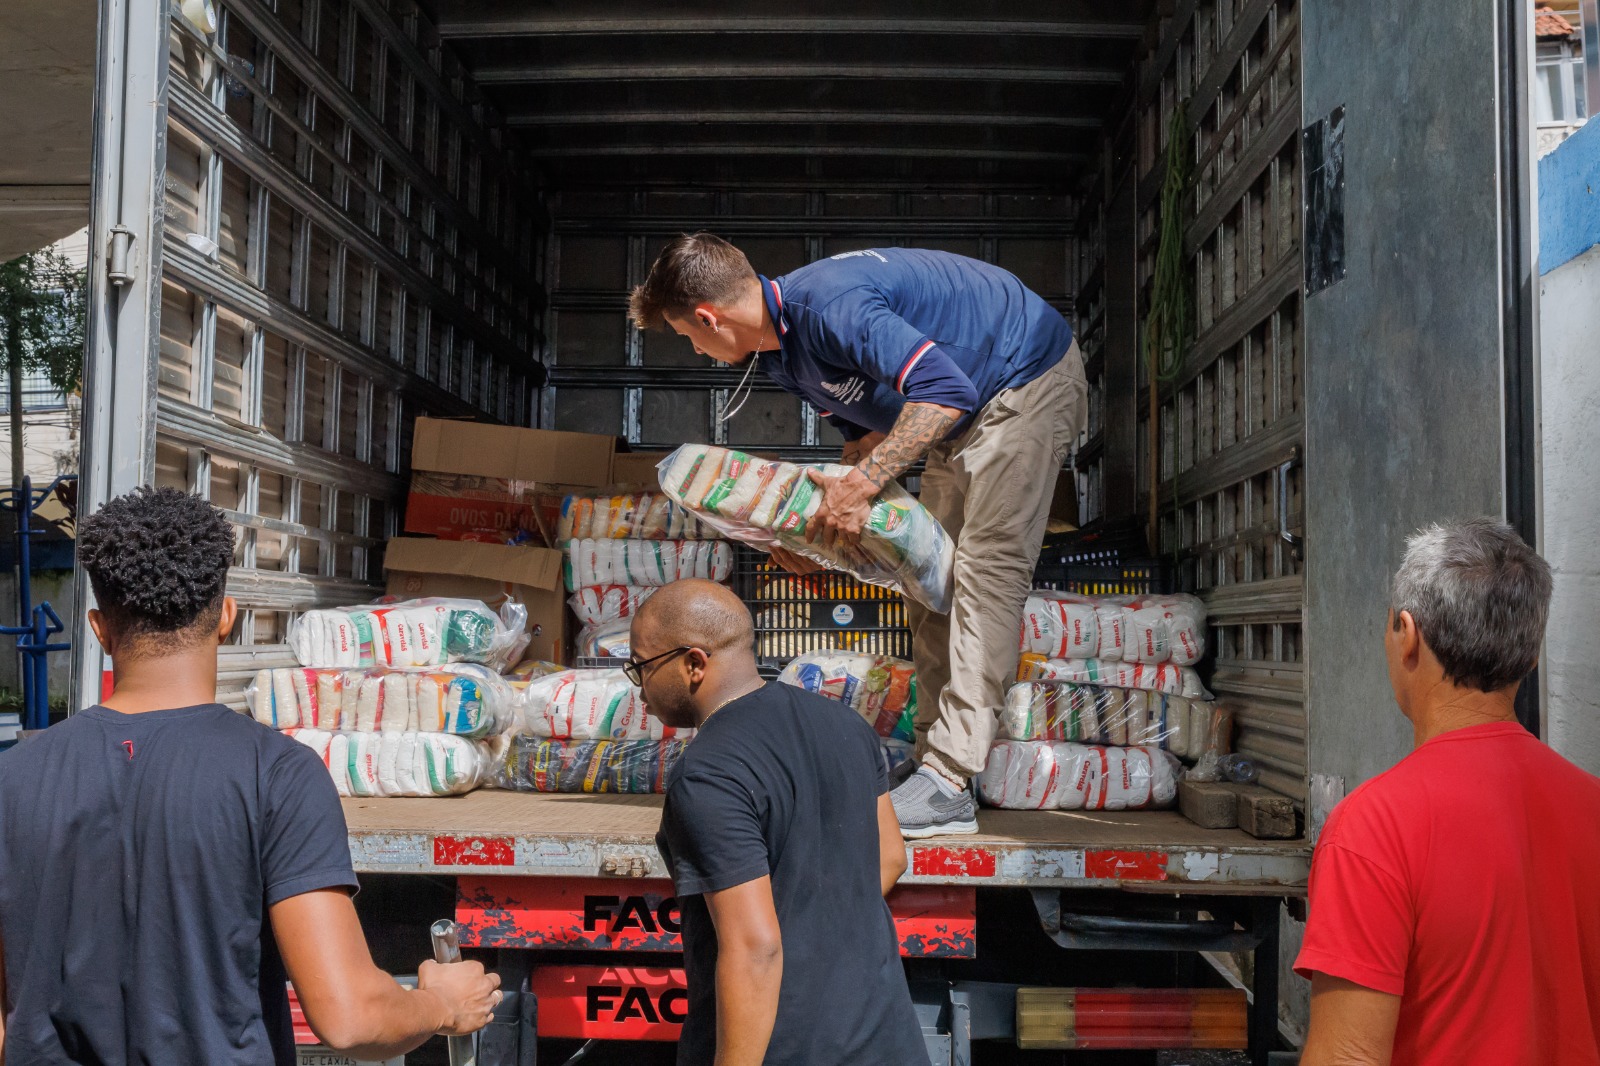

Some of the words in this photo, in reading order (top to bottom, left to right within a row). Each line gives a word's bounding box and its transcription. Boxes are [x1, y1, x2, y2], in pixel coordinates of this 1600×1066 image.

[450, 507, 488, 527] OVOS
[339, 624, 348, 652] Caravelas
[397, 623, 408, 652] Caravelas
[418, 622, 429, 650] Caravelas
[586, 696, 599, 726] Caravelas
[1076, 760, 1091, 792] Caravelas
[302, 1056, 315, 1066] DE
